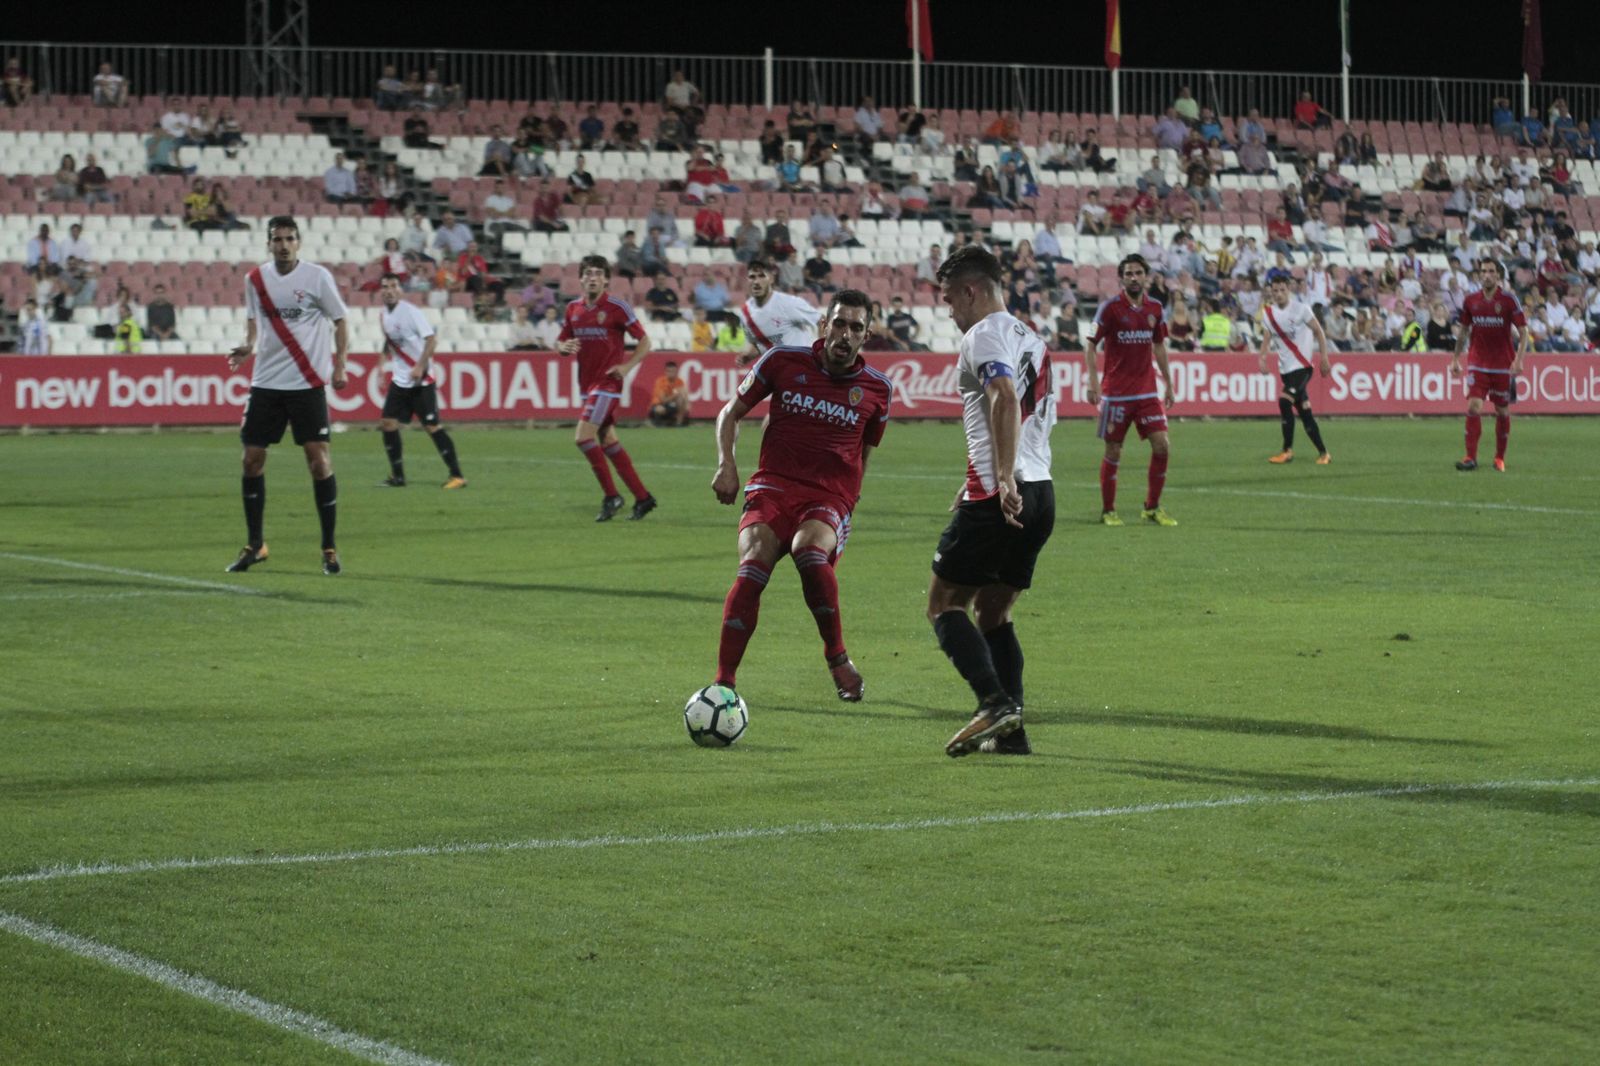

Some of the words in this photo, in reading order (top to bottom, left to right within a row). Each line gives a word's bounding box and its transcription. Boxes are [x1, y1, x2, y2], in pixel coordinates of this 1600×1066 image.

[15, 377, 101, 409] new
[108, 367, 252, 407] balanc
[324, 360, 643, 411] CDIALIY
[678, 359, 750, 402] Cru
[886, 360, 961, 408] Radl
[781, 390, 860, 425] CARAVAN
[1110, 406, 1125, 423] 15
